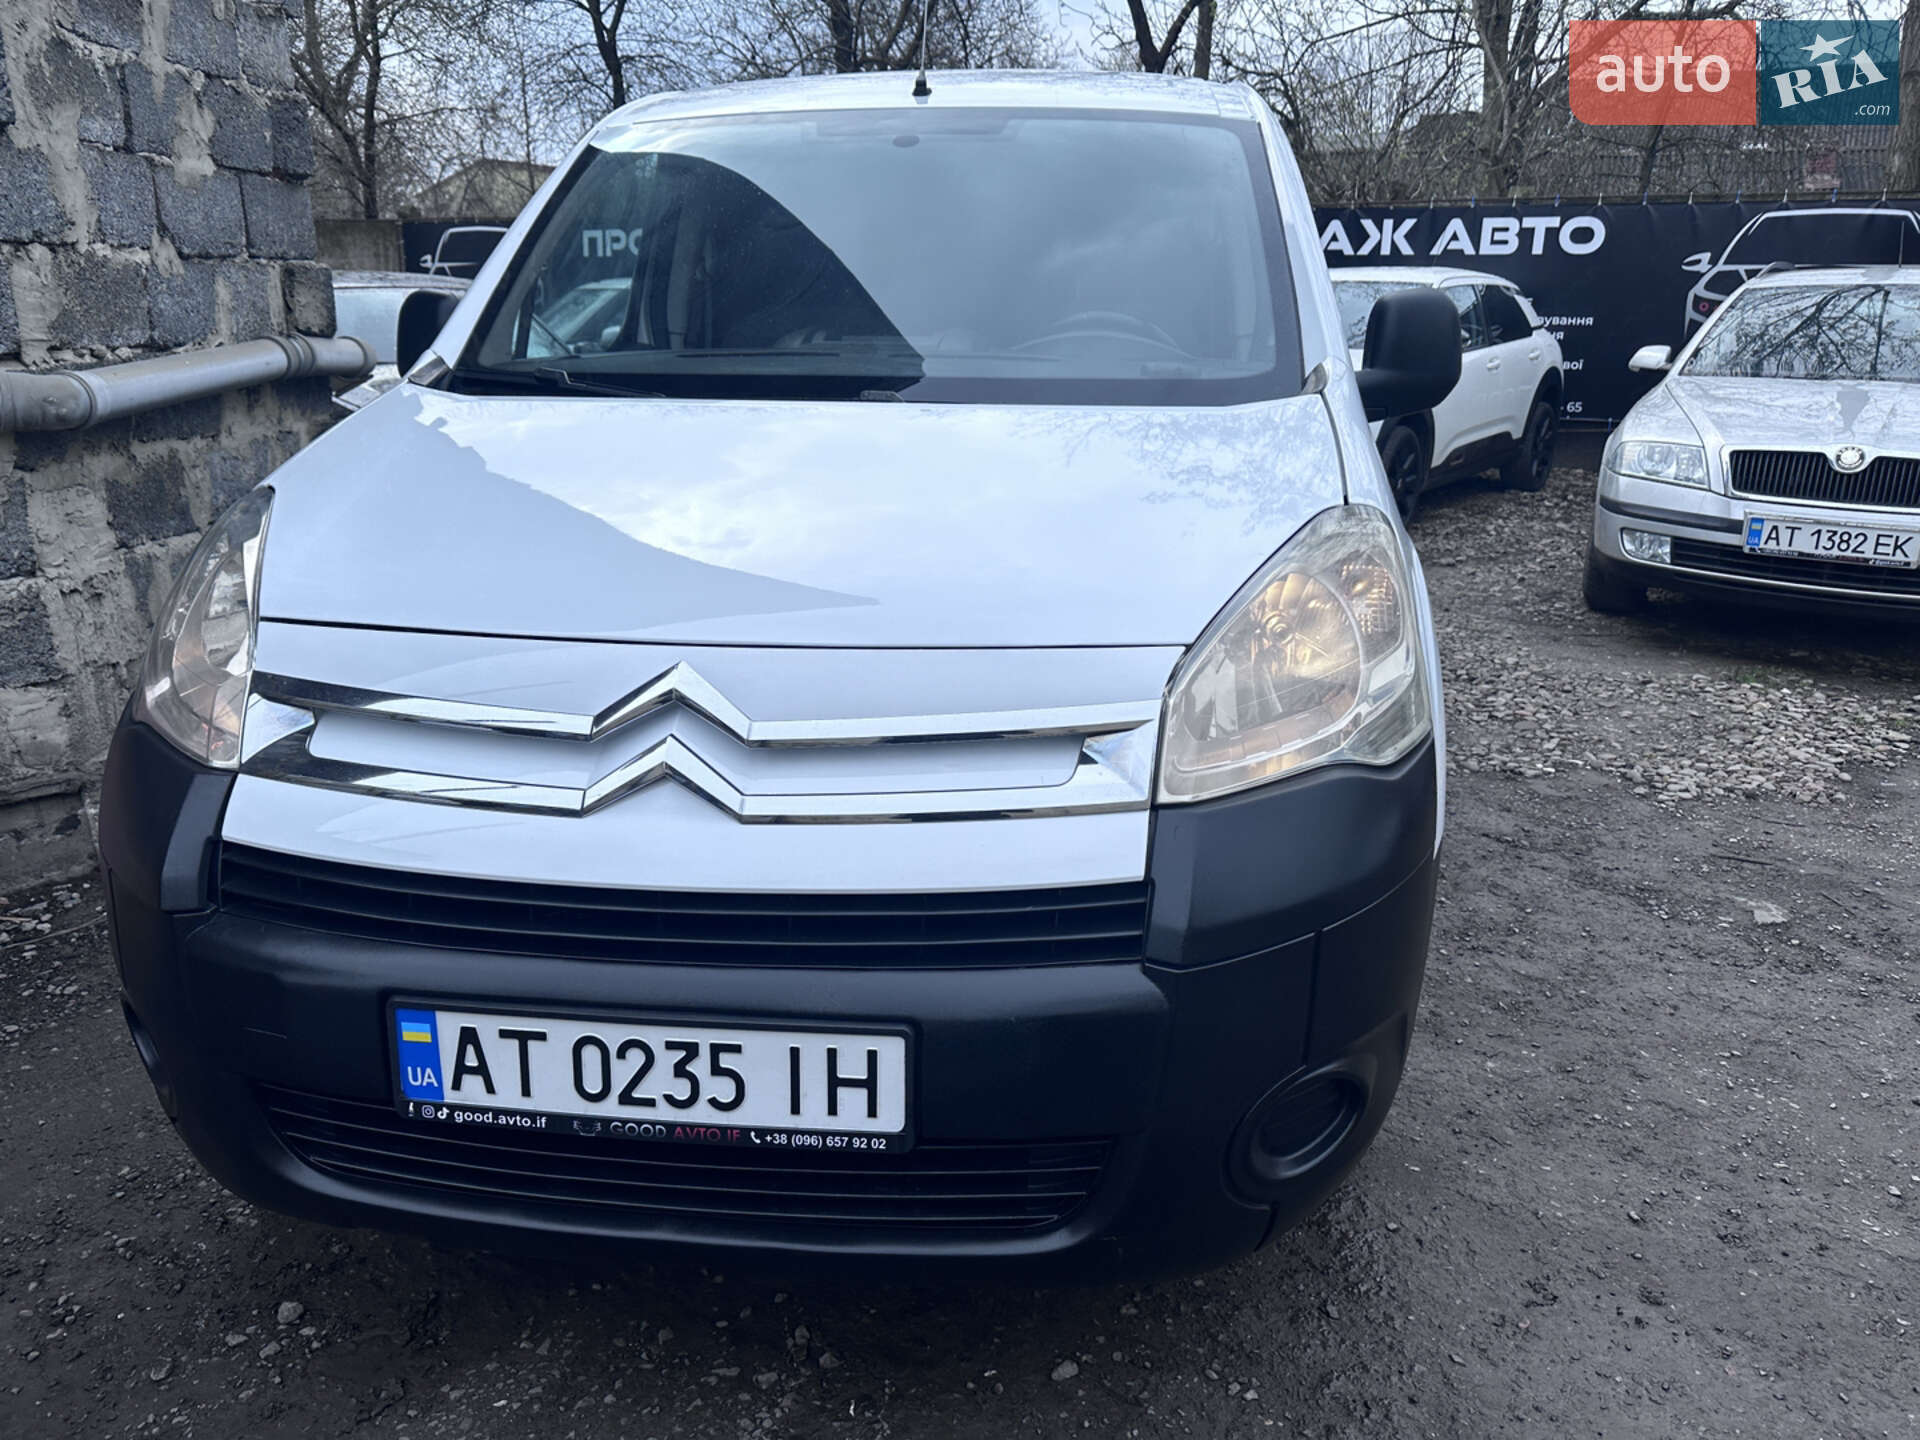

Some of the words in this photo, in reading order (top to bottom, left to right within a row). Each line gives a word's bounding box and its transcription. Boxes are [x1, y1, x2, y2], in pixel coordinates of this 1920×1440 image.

[1320, 217, 1418, 256] АЖ
[1429, 215, 1606, 256] АВТО
[1764, 525, 1802, 548] AT
[1810, 528, 1868, 555] 1382
[1873, 533, 1914, 559] EK
[407, 1066, 438, 1088] UA
[451, 1025, 548, 1098] AT
[571, 1034, 746, 1112] 0235
[789, 1045, 878, 1119] IH
[454, 1110, 548, 1129] good.avto.if
[609, 1121, 667, 1138] GOOD
[673, 1126, 721, 1142] AVTO
[764, 1133, 788, 1145] +38
[791, 1135, 823, 1149] (096)
[826, 1136, 848, 1148] 657
[852, 1137, 867, 1149] 92
[871, 1138, 887, 1150] 02
